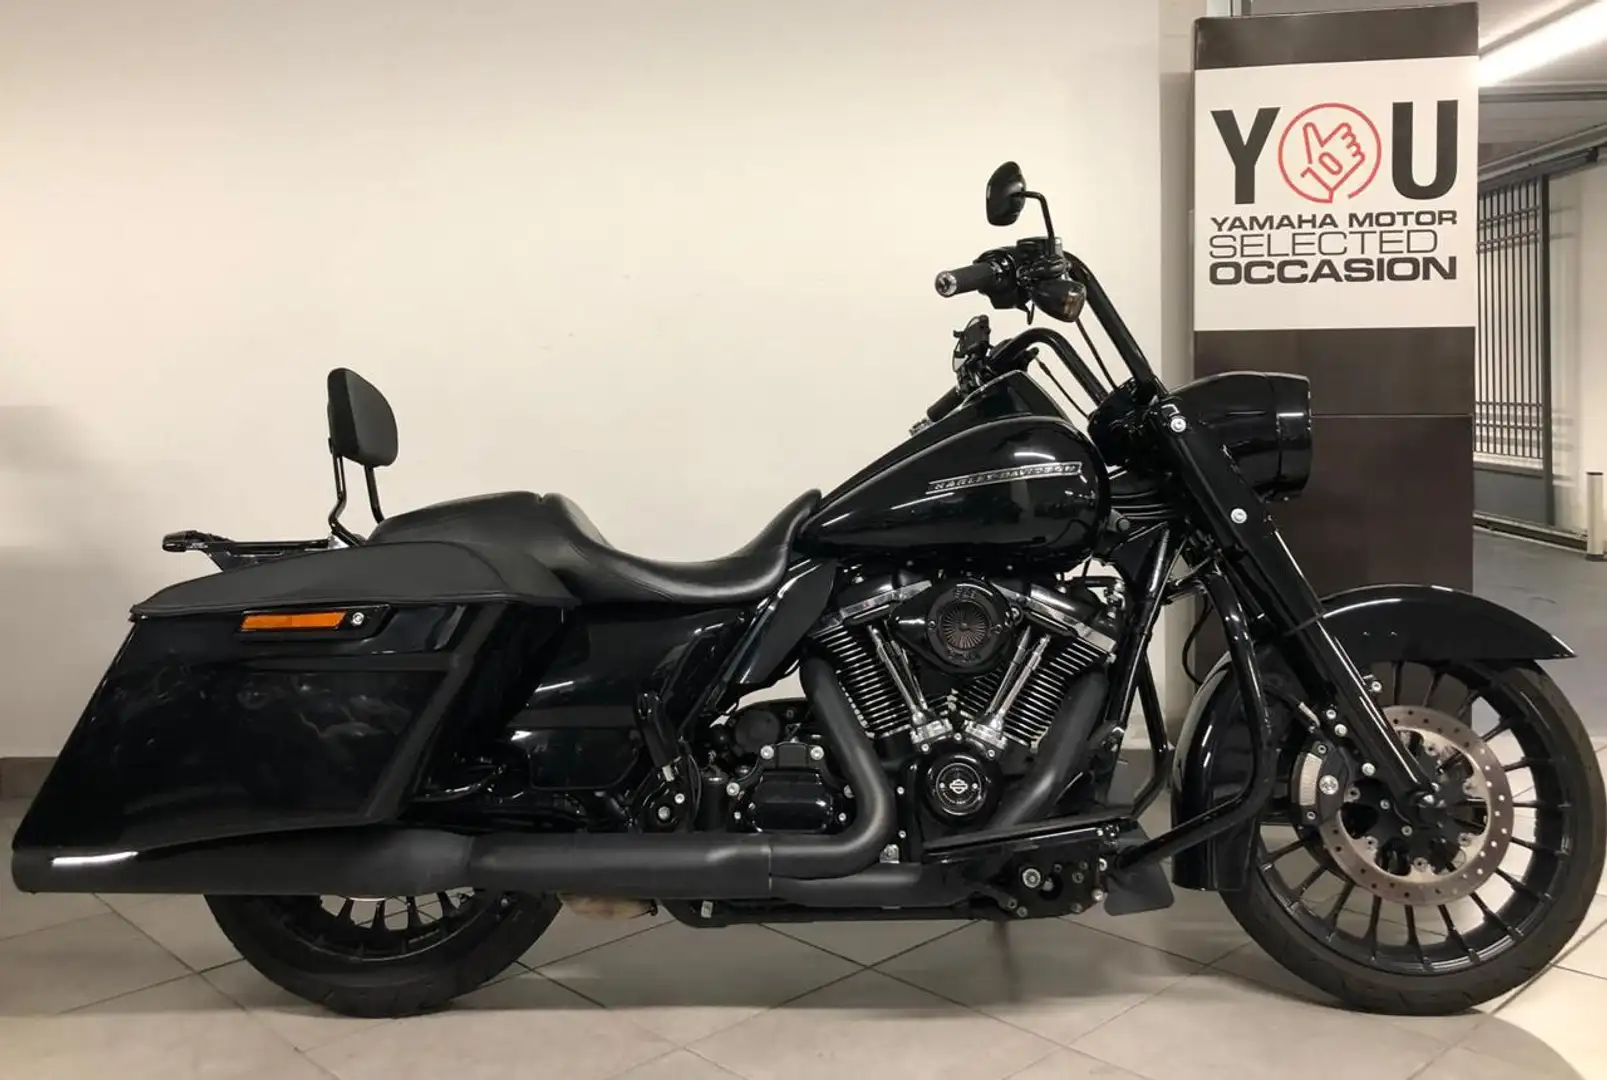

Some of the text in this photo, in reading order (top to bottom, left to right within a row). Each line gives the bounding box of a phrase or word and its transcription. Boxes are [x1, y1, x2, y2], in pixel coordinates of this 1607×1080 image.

[1210, 210, 1458, 232] YAMAHA MOTOR
[1209, 229, 1438, 259] SELECTED
[1209, 256, 1457, 285] OCCASION
